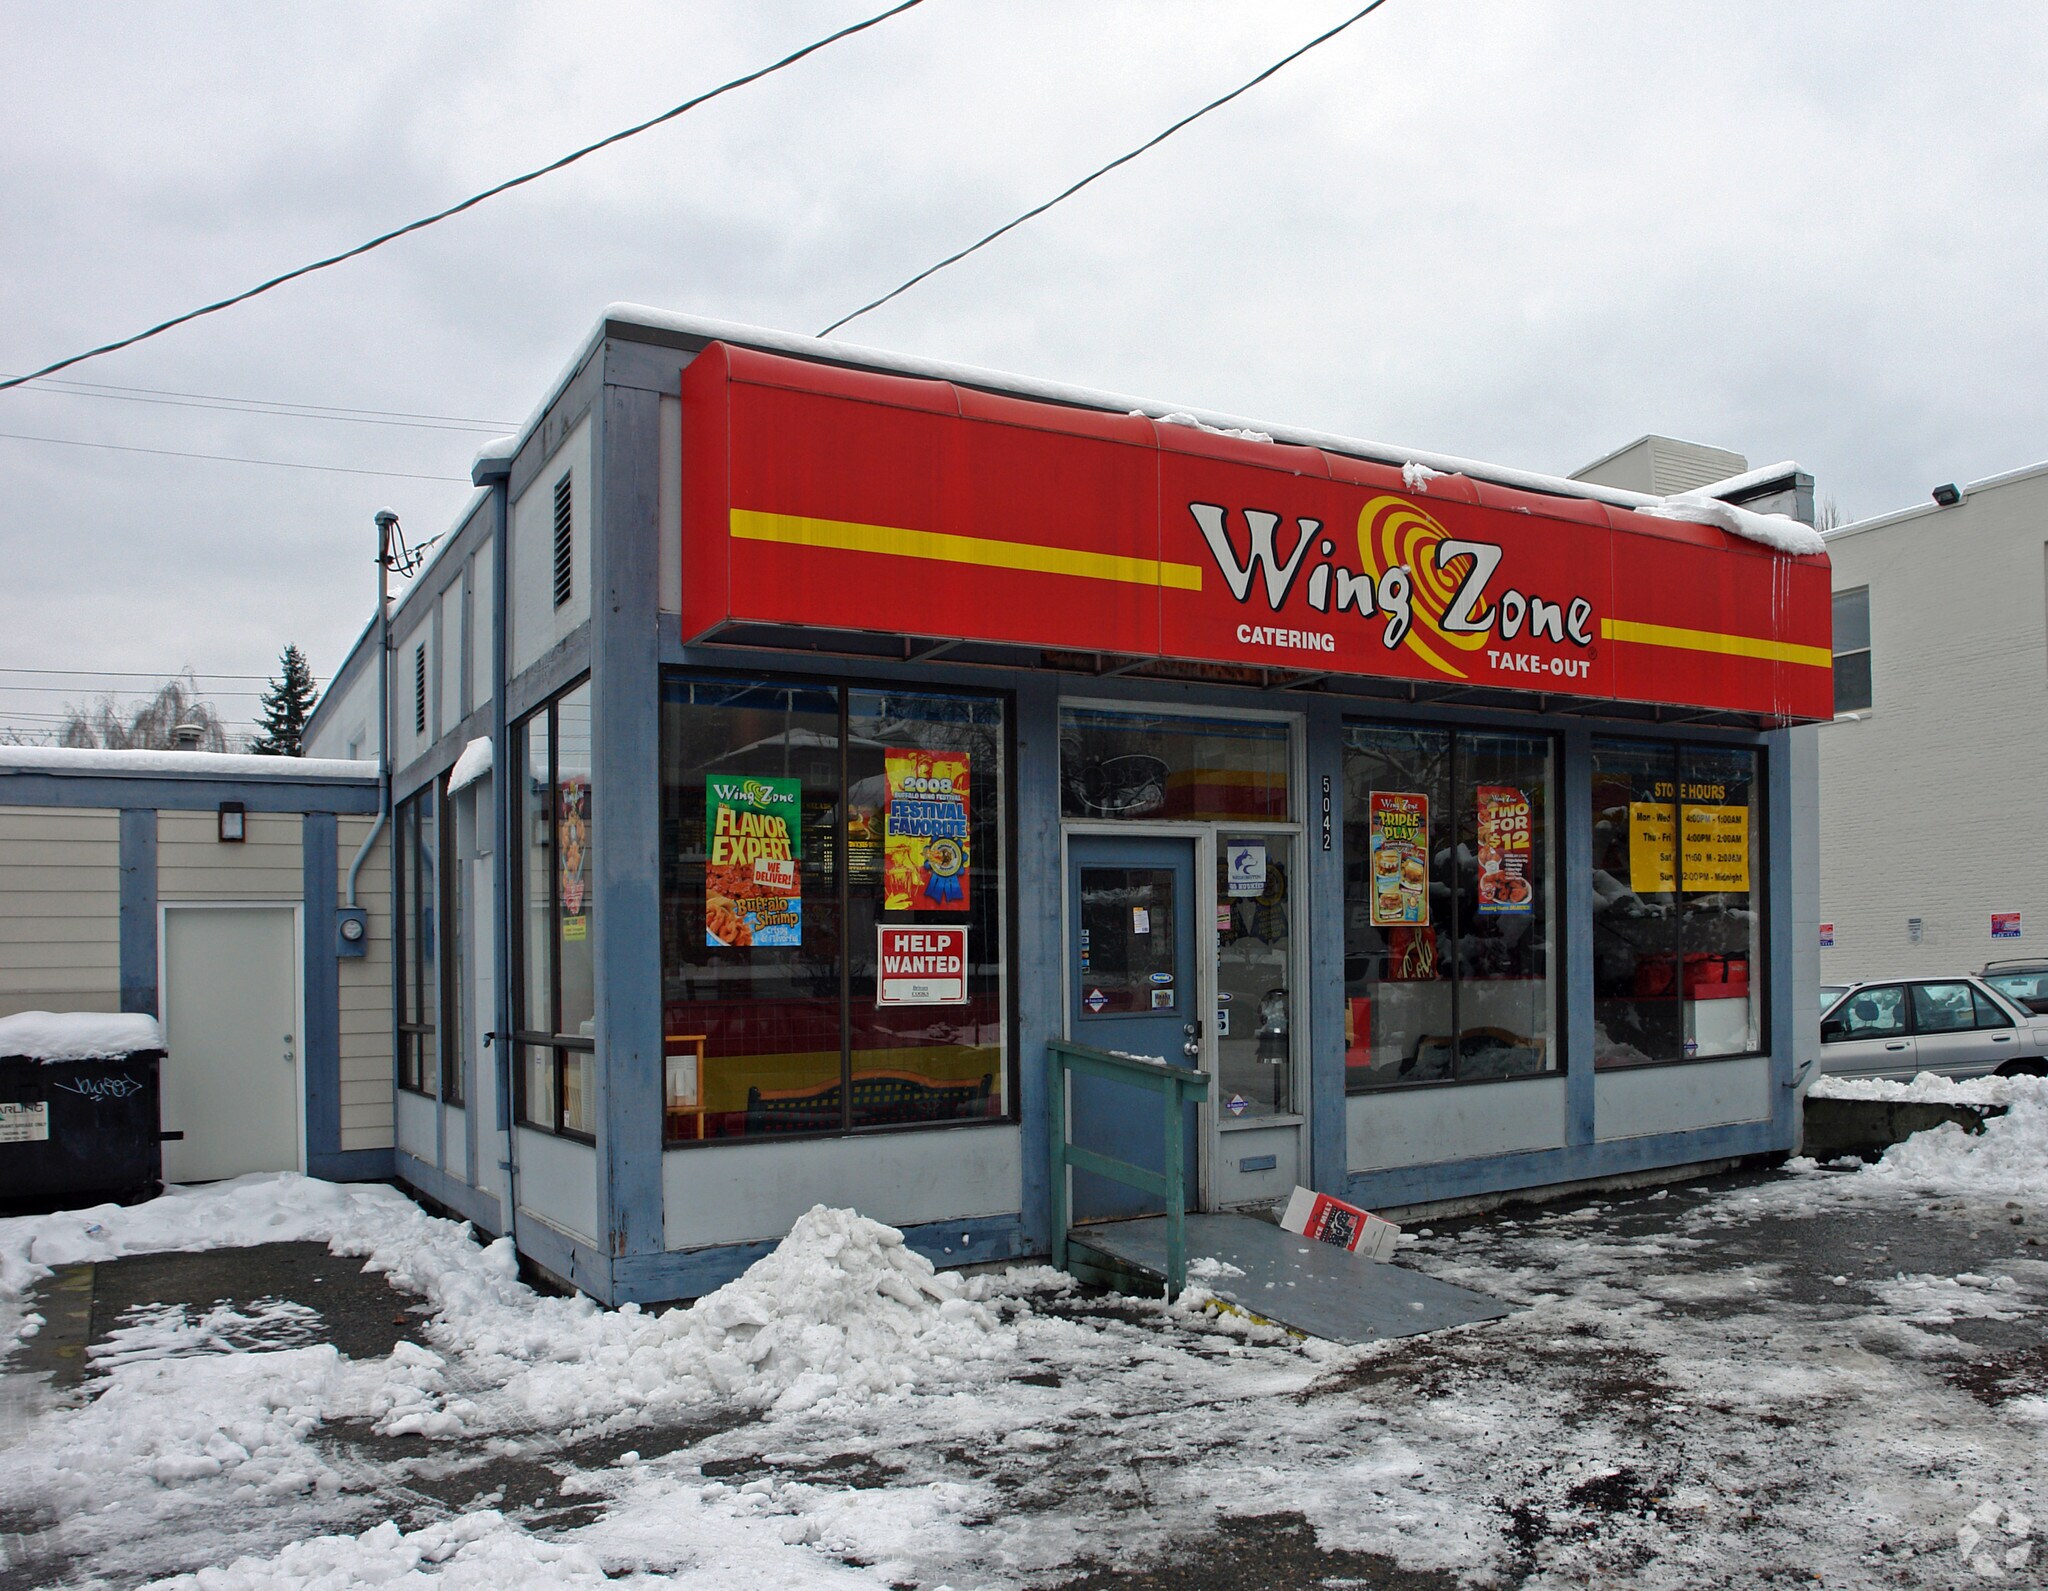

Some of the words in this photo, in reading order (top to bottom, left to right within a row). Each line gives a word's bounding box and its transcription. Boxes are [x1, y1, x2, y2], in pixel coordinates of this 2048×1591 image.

[1189, 502, 1413, 650] Wing
[1435, 538, 1592, 646] Zone
[1236, 624, 1336, 653] CATERING
[1487, 650, 1590, 679] TAKE-OUT
[904, 776, 953, 794] 2008
[1654, 782, 1686, 799] STOE
[1689, 784, 1726, 800] HOURS
[713, 784, 755, 805] Wing
[760, 785, 795, 803] Zone
[891, 799, 968, 821] FESTIVAL
[1322, 777, 1331, 850] 5042
[1380, 798, 1400, 811] Wing
[1402, 799, 1418, 811] Zone
[1488, 803, 1529, 820] TWO
[715, 807, 790, 839] FLAVOR
[1378, 811, 1421, 827] TRIPLE
[1490, 815, 1528, 833] FOR
[1636, 812, 1651, 822] Mon
[1656, 813, 1671, 823] Wed
[888, 816, 968, 838] FAVORITE
[1384, 826, 1415, 841] PLAY
[1489, 830, 1530, 851] $12
[1643, 832, 1656, 842] Thu
[1662, 833, 1672, 843] Fri
[1686, 834, 1711, 843] 4:00PM
[1717, 834, 1742, 843] 2:00AM
[711, 835, 793, 866] EXPERT
[1660, 852, 1673, 862] Sat
[1685, 853, 1712, 862] 11:00M
[1717, 853, 1742, 862] 2:00AM
[767, 862, 781, 872] WE
[755, 870, 792, 885] DELIVER!
[1659, 872, 1674, 882] Sun
[1681, 871, 1710, 881] 2:00PM
[1715, 872, 1742, 883] Midnight
[736, 896, 789, 916] Buffalo
[755, 910, 799, 931] Shrimp
[894, 934, 952, 952] HELP
[883, 955, 961, 973] WANTED
[1314, 1225, 1323, 1240] ICE
[1319, 1201, 1333, 1224] MELT
